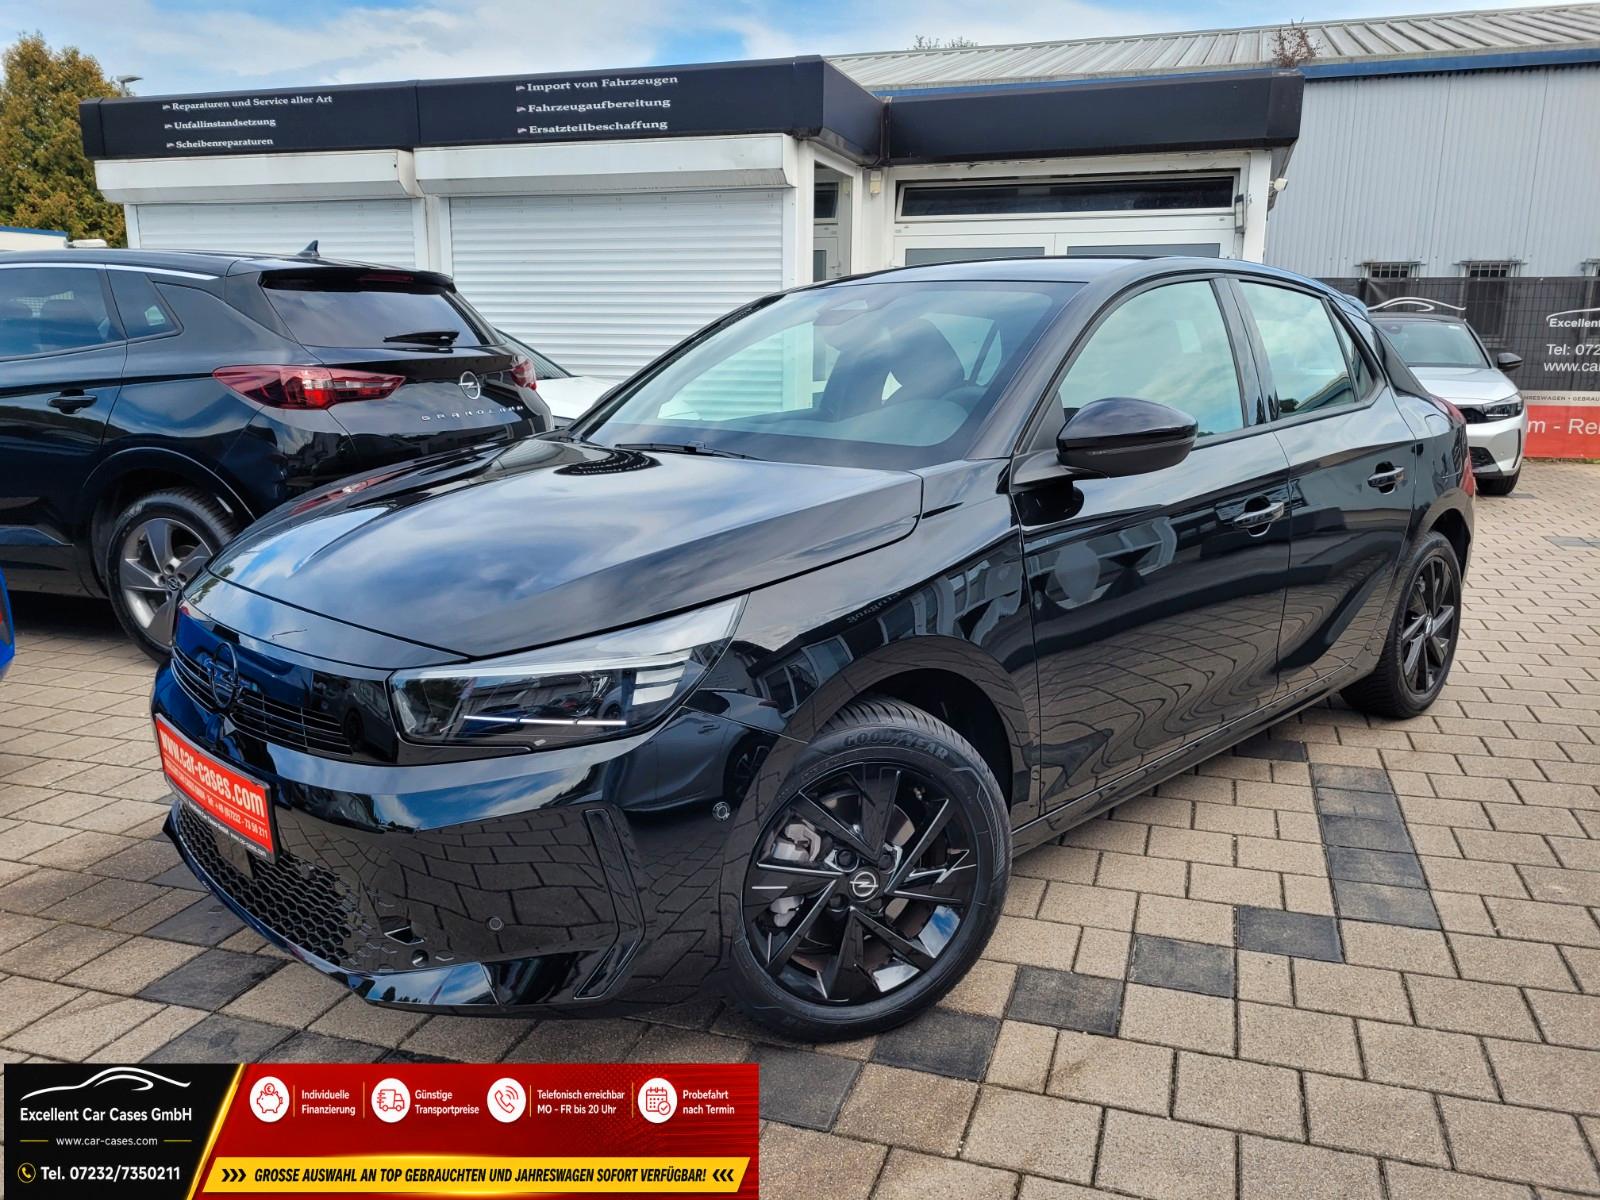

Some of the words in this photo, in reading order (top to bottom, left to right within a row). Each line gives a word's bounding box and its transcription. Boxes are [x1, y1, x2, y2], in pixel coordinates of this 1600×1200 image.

[527, 81, 570, 92] Import
[602, 77, 678, 87] Fahrzeugen
[172, 101, 230, 111] Reparaturen
[232, 99, 251, 108] und
[253, 97, 289, 106] Service
[290, 96, 313, 104] aller
[316, 95, 333, 103] Art
[528, 99, 671, 113] Fahrzeugaufbereitung
[174, 118, 276, 129] Unfallinstandsetzung
[529, 121, 668, 134] Ersatzteilbeschaffung
[176, 138, 273, 149] Scheibenreparaturen
[1546, 344, 1571, 355] Tel:
[844, 732, 950, 760] GOODYEAR
[159, 729, 265, 818] www.car-cases.com
